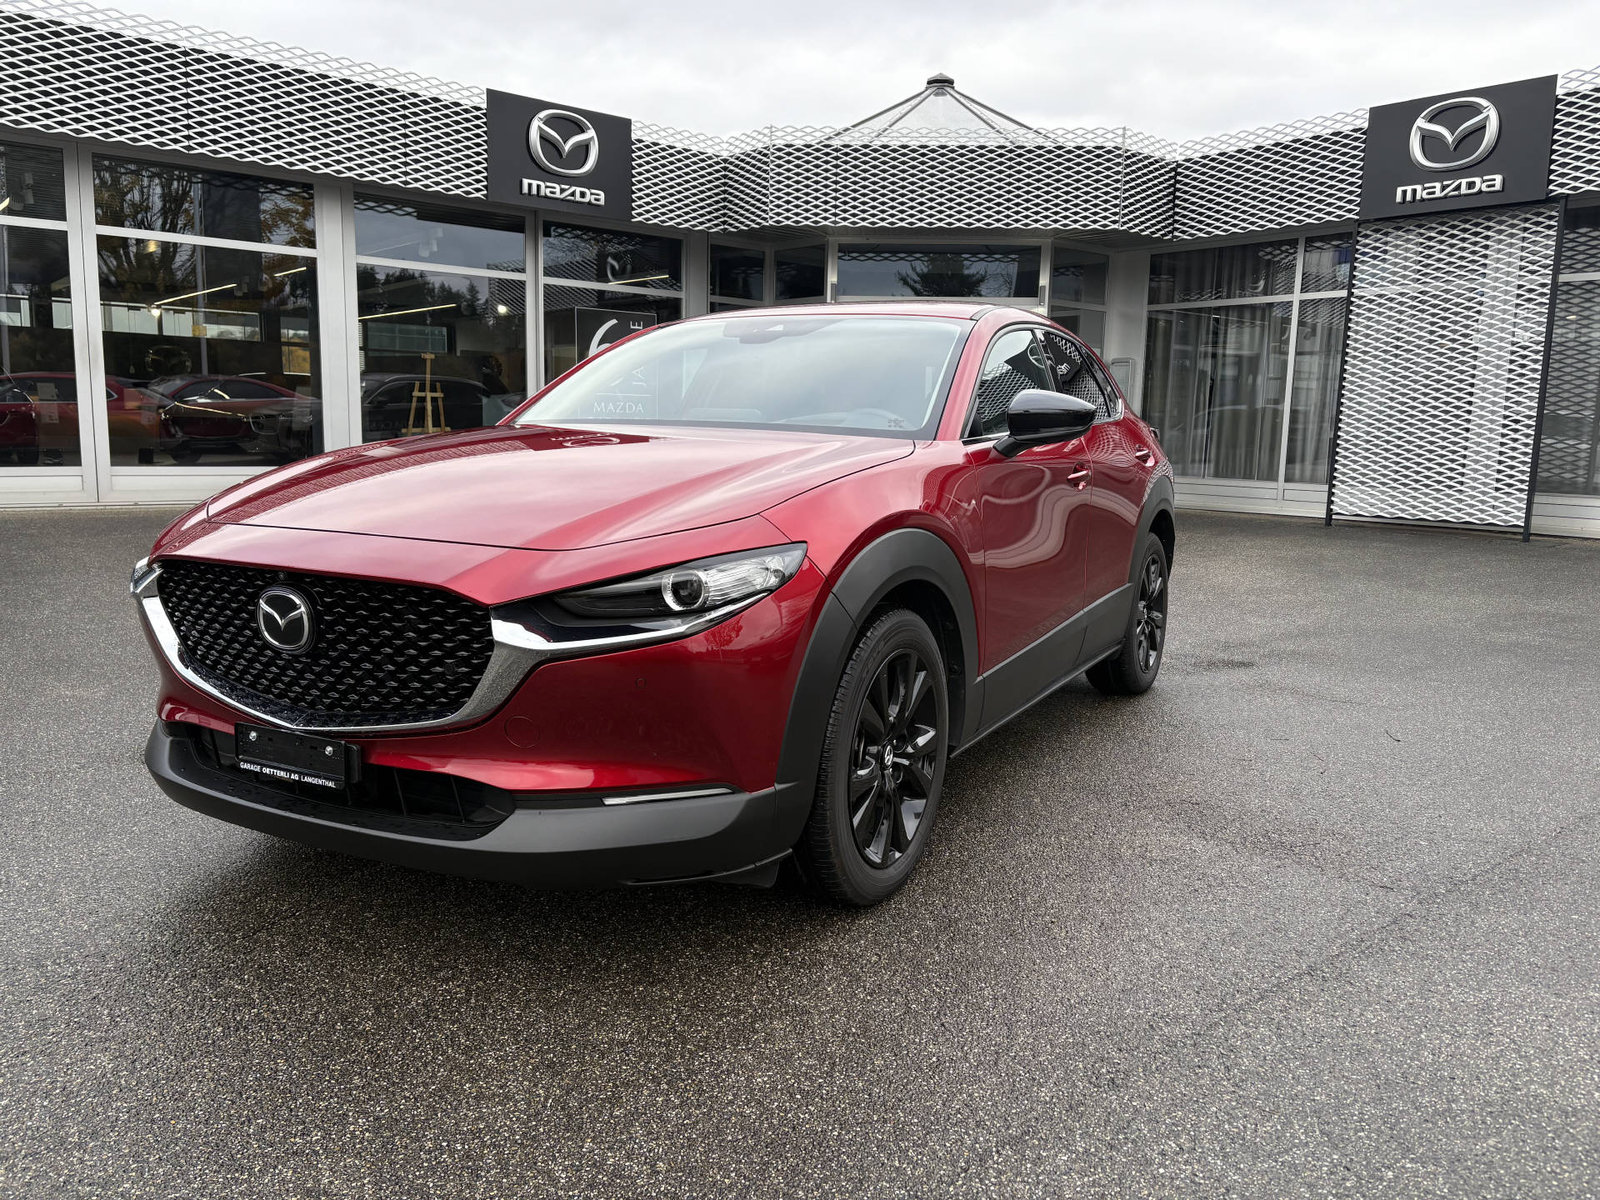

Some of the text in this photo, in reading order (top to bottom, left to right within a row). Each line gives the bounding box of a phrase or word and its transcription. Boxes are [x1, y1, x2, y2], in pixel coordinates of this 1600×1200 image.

[521, 178, 605, 206] mazda
[1396, 174, 1503, 203] mazda
[593, 401, 645, 414] MAZDA
[240, 761, 261, 773] GARAGE
[262, 768, 290, 778] OETTERLI
[301, 775, 336, 788] LANGENTHAL
